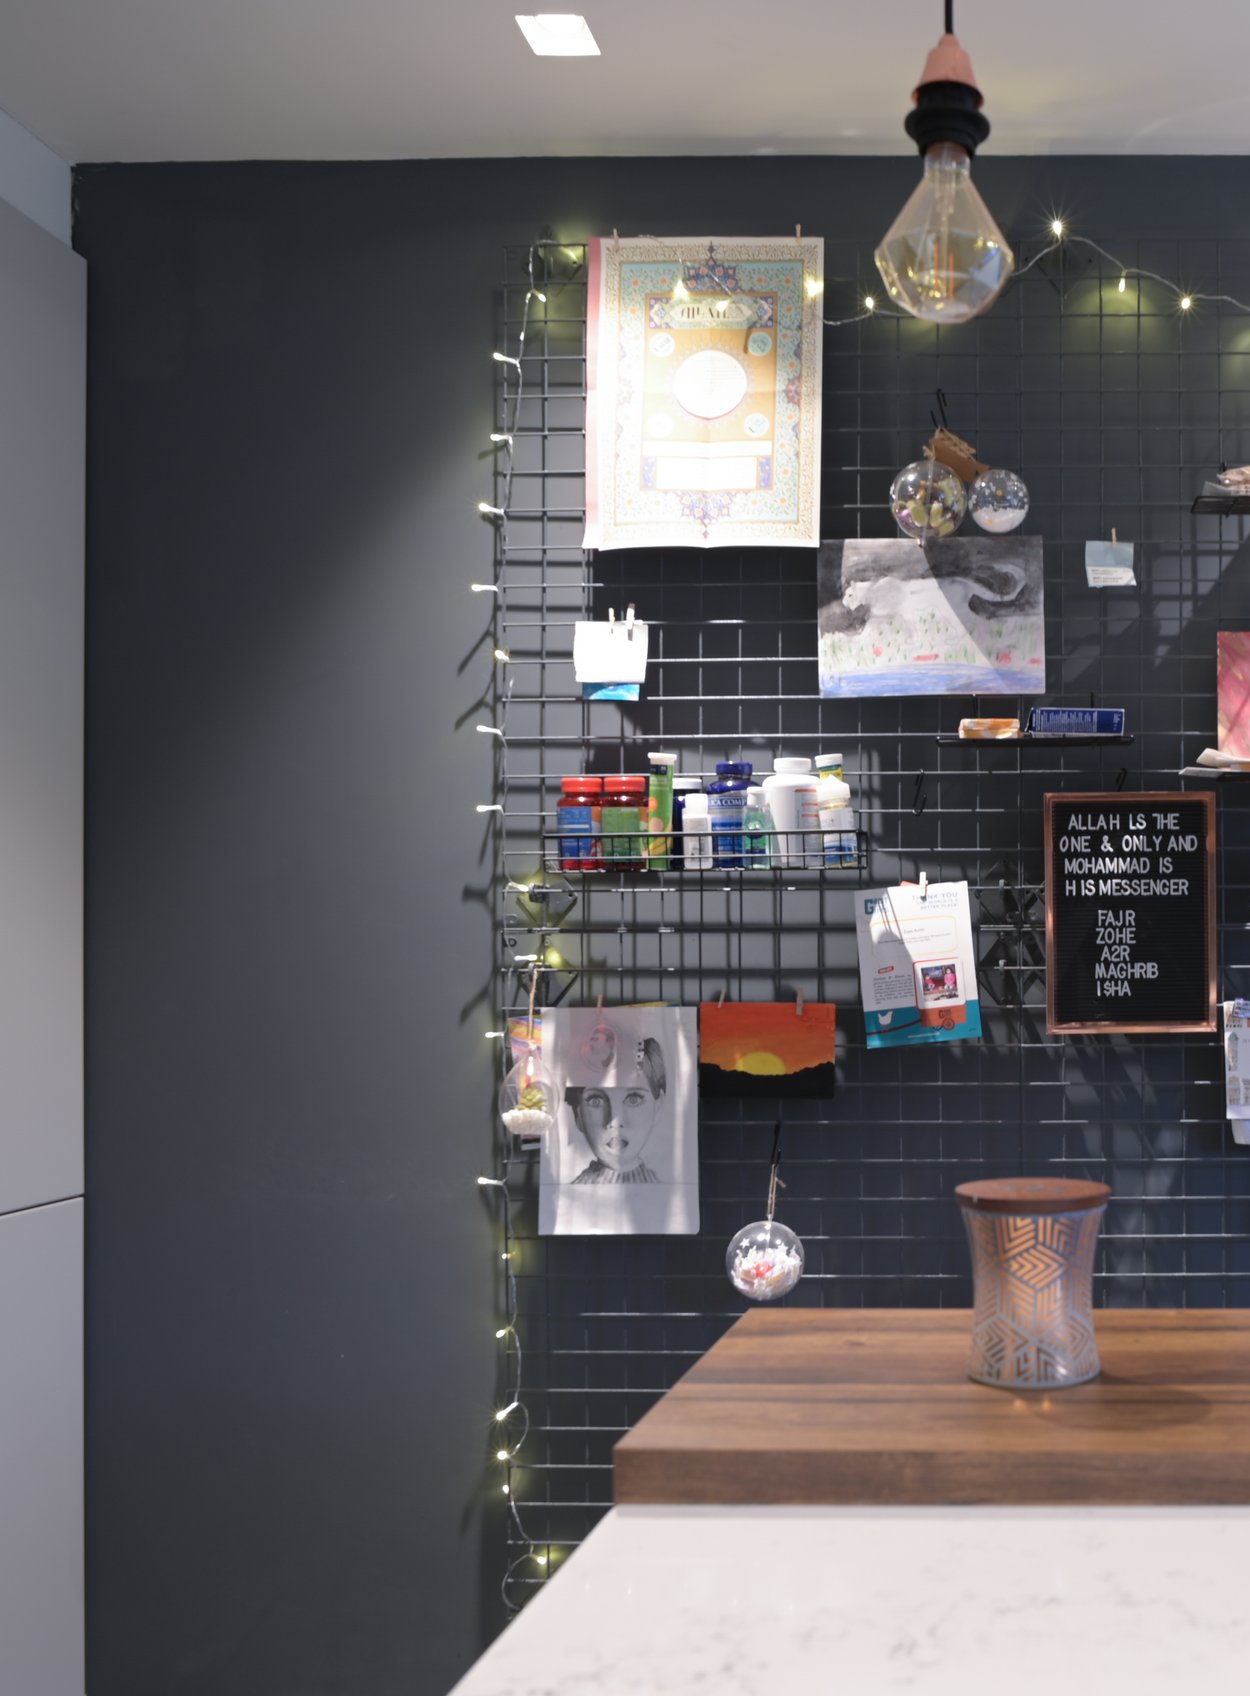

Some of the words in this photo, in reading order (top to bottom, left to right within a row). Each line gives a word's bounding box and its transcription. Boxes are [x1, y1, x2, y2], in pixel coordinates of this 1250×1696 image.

[1067, 813, 1120, 831] ALLAH
[1152, 813, 1180, 830] THE
[1059, 835, 1091, 853] ONE
[1100, 835, 1114, 853] &
[1121, 834, 1162, 852] ONLY
[1167, 835, 1198, 852] AND
[1064, 857, 1150, 874] MOHAMMAD
[1158, 857, 1173, 874] IS
[1098, 879, 1189, 897] MESSENGER
[1097, 909, 1136, 927] FAJR
[1095, 927, 1136, 944] ZOHE
[1095, 962, 1159, 979] MAGHRIB
